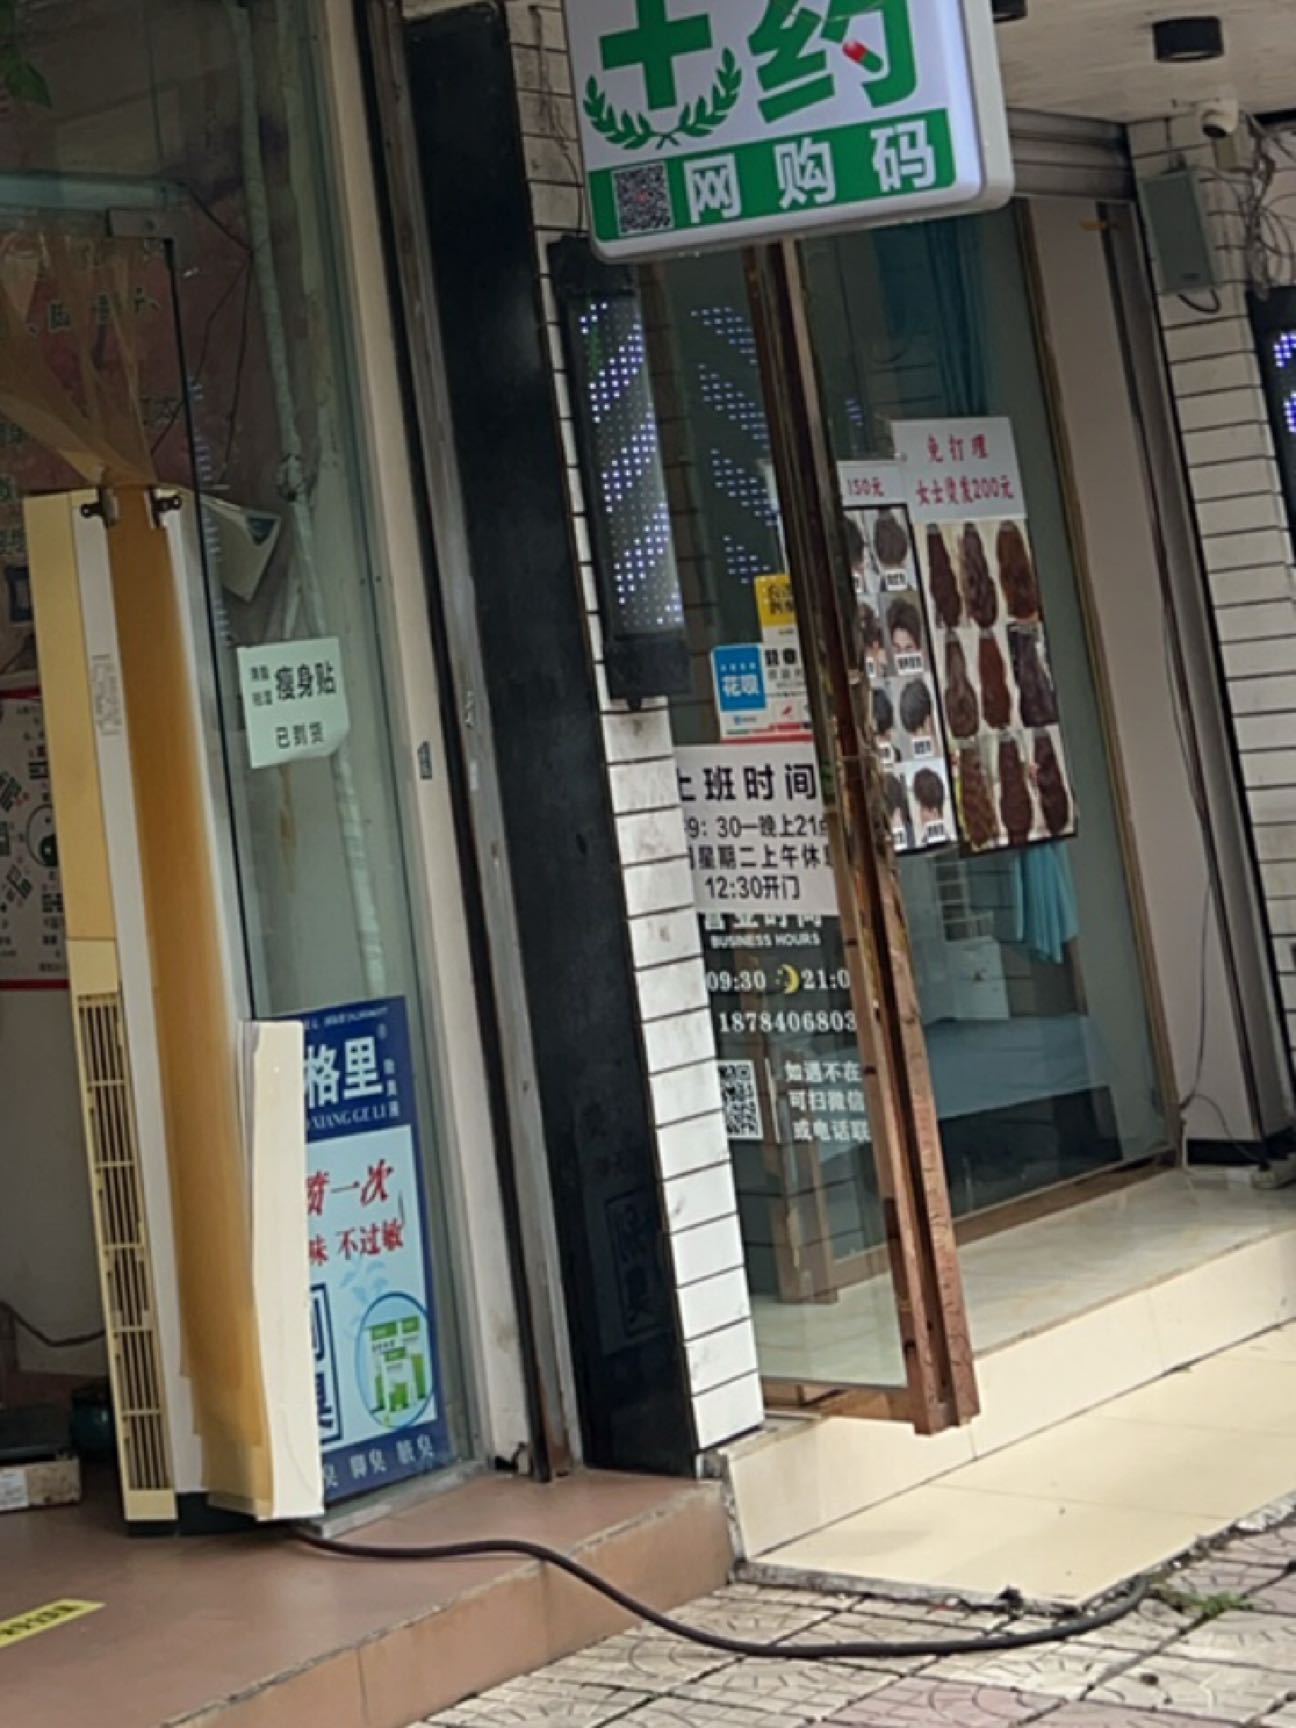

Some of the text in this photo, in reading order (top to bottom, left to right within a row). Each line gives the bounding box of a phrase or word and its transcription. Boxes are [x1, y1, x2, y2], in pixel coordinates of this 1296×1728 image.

[683, 121, 936, 223] 网购码
[711, 933, 821, 949] BUSINESS HOURS
